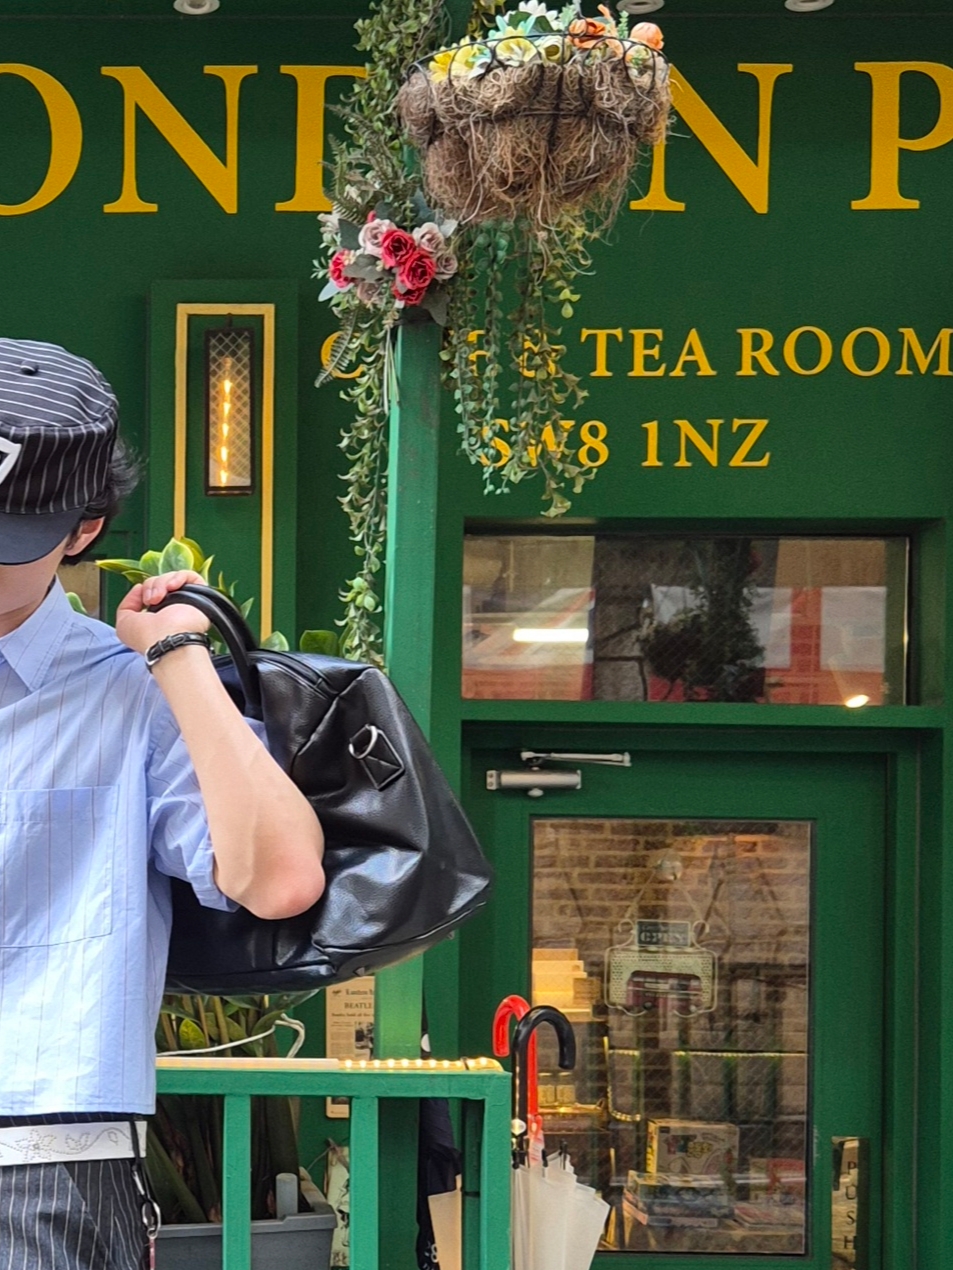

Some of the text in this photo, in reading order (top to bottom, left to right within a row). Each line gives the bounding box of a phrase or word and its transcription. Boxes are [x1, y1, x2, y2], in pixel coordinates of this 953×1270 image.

[579, 326, 717, 378] TEA
[736, 325, 953, 378] ROOM
[641, 418, 771, 468] 1NZ
[843, 1160, 858, 1251] PUSH
